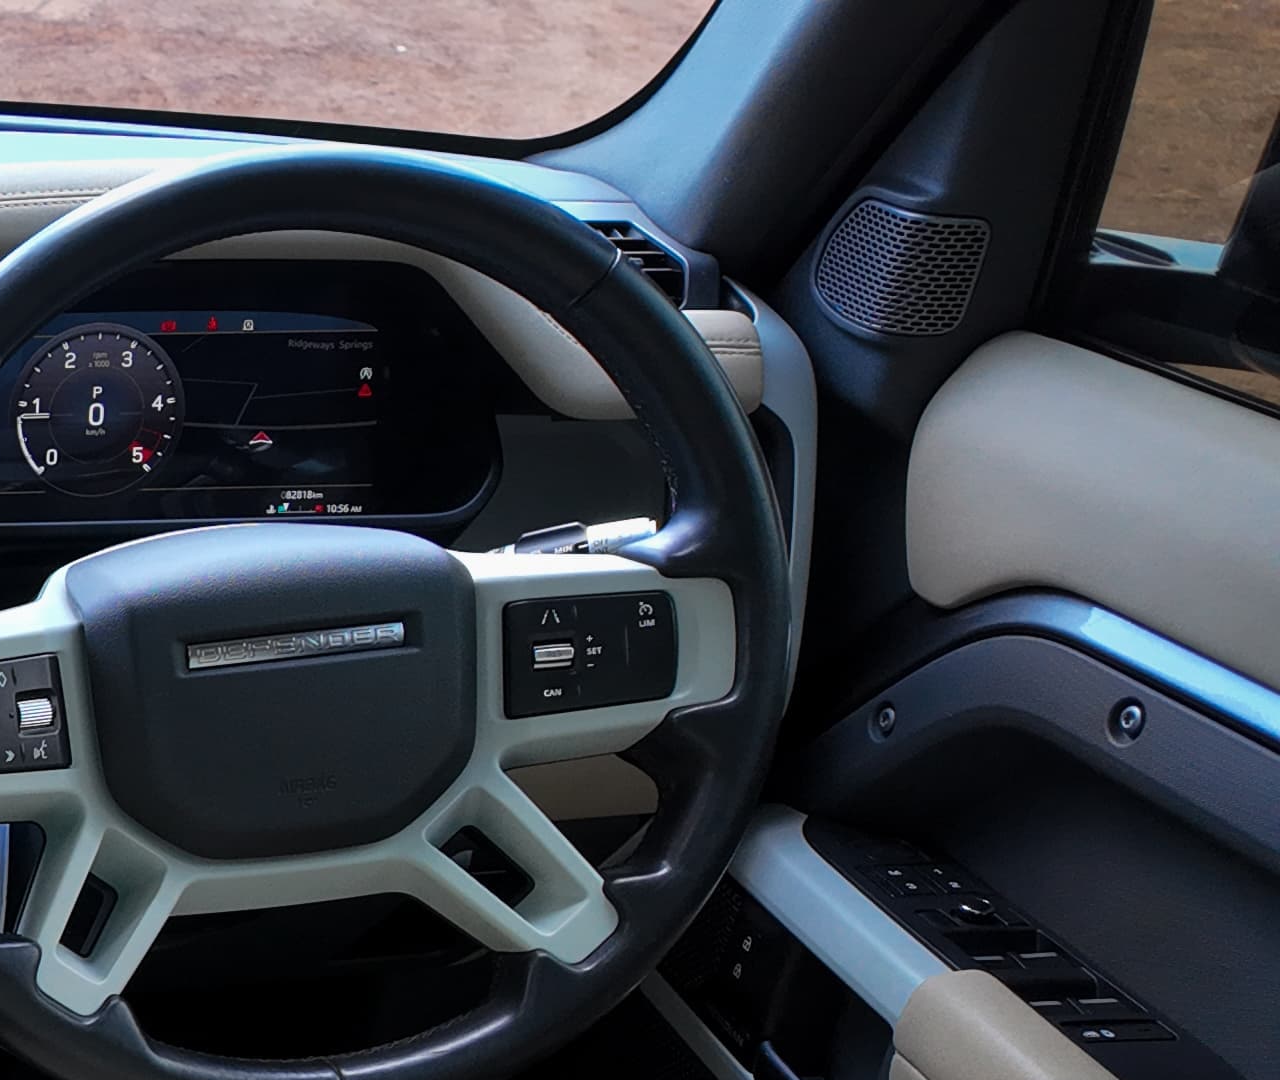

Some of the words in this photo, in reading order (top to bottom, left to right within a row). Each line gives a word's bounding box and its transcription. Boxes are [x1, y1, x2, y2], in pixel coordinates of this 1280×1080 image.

[288, 339, 335, 350] Ridgeways
[339, 340, 373, 351] Springs
[64, 352, 77, 369] 2
[94, 360, 110, 368] 1000
[121, 351, 133, 368] 3
[93, 386, 103, 399] P
[32, 398, 40, 414] 1
[152, 395, 164, 411] 4
[88, 402, 105, 426] 0
[46, 449, 58, 465] 0
[132, 447, 144, 463] 5
[326, 504, 349, 513] 10:56
[351, 505, 362, 513] AM
[197, 624, 401, 664] DEFENDER
[586, 646, 602, 655] SET
[543, 688, 562, 697] CAN
